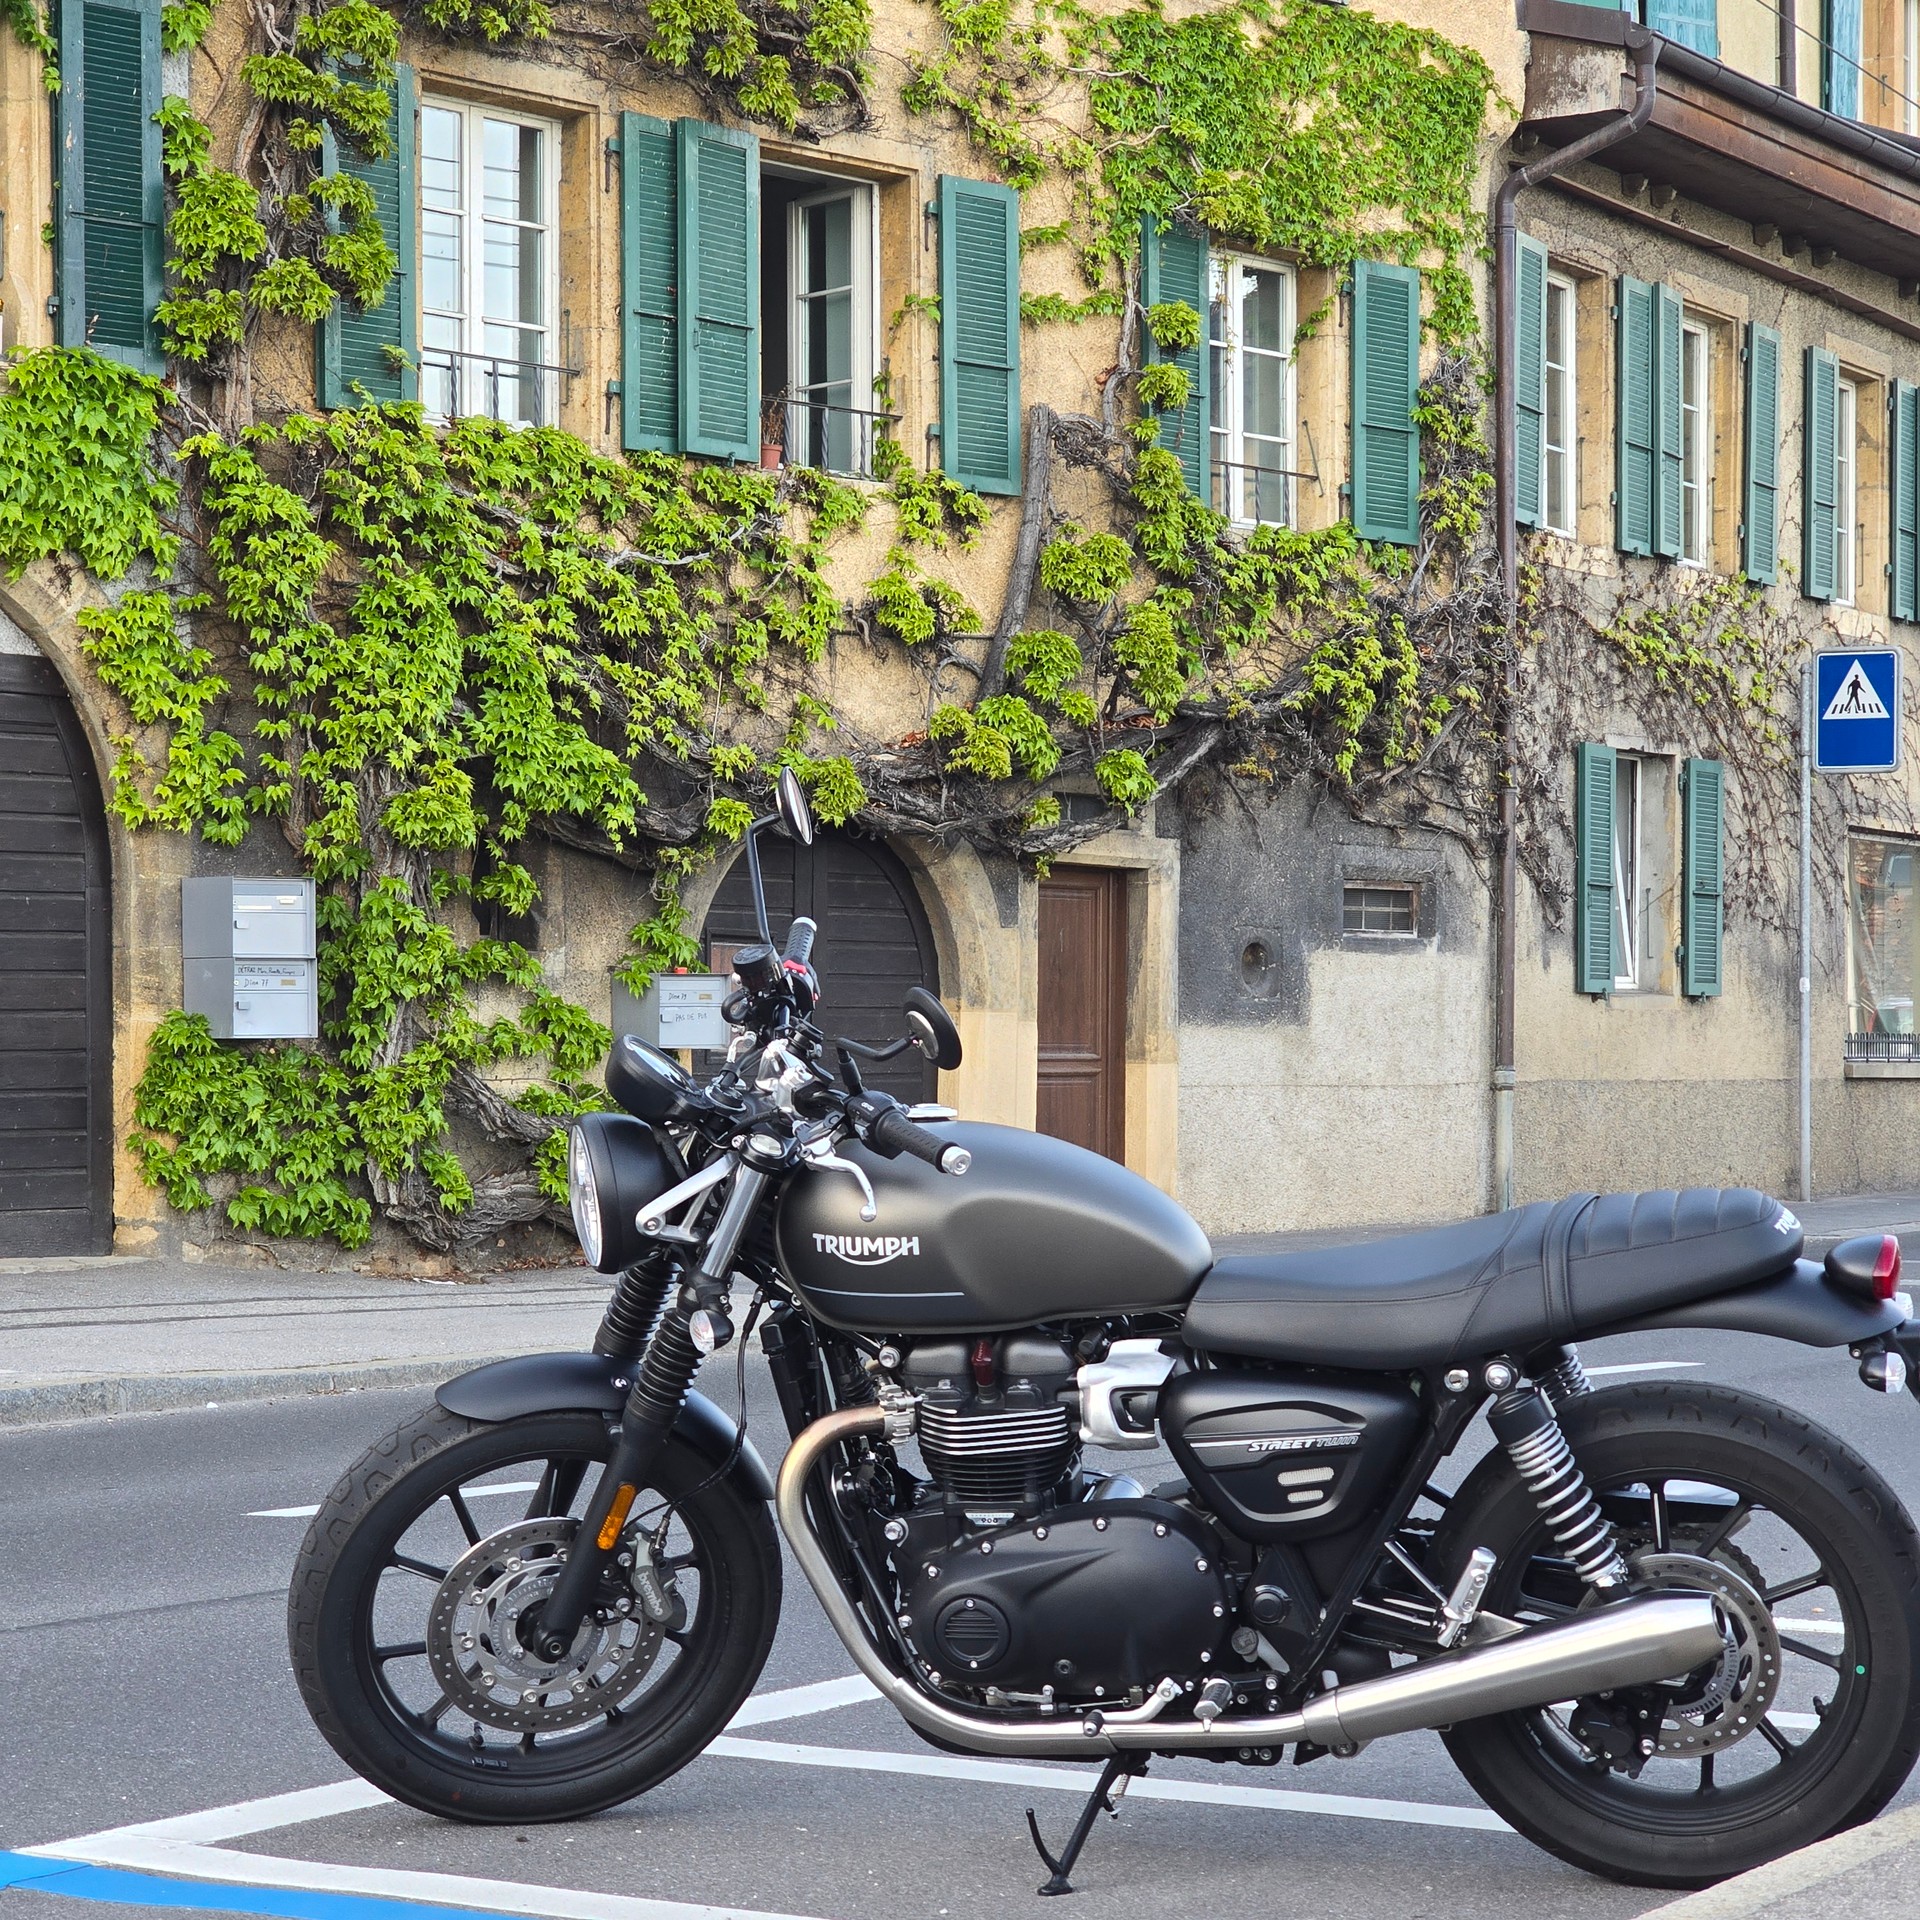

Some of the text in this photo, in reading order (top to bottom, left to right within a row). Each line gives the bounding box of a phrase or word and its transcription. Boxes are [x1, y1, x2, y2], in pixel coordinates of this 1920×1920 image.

[812, 1233, 920, 1266] TRIUMPH
[1248, 1436, 1359, 1451] STREET TWIN
[637, 1570, 664, 1616] brembo
